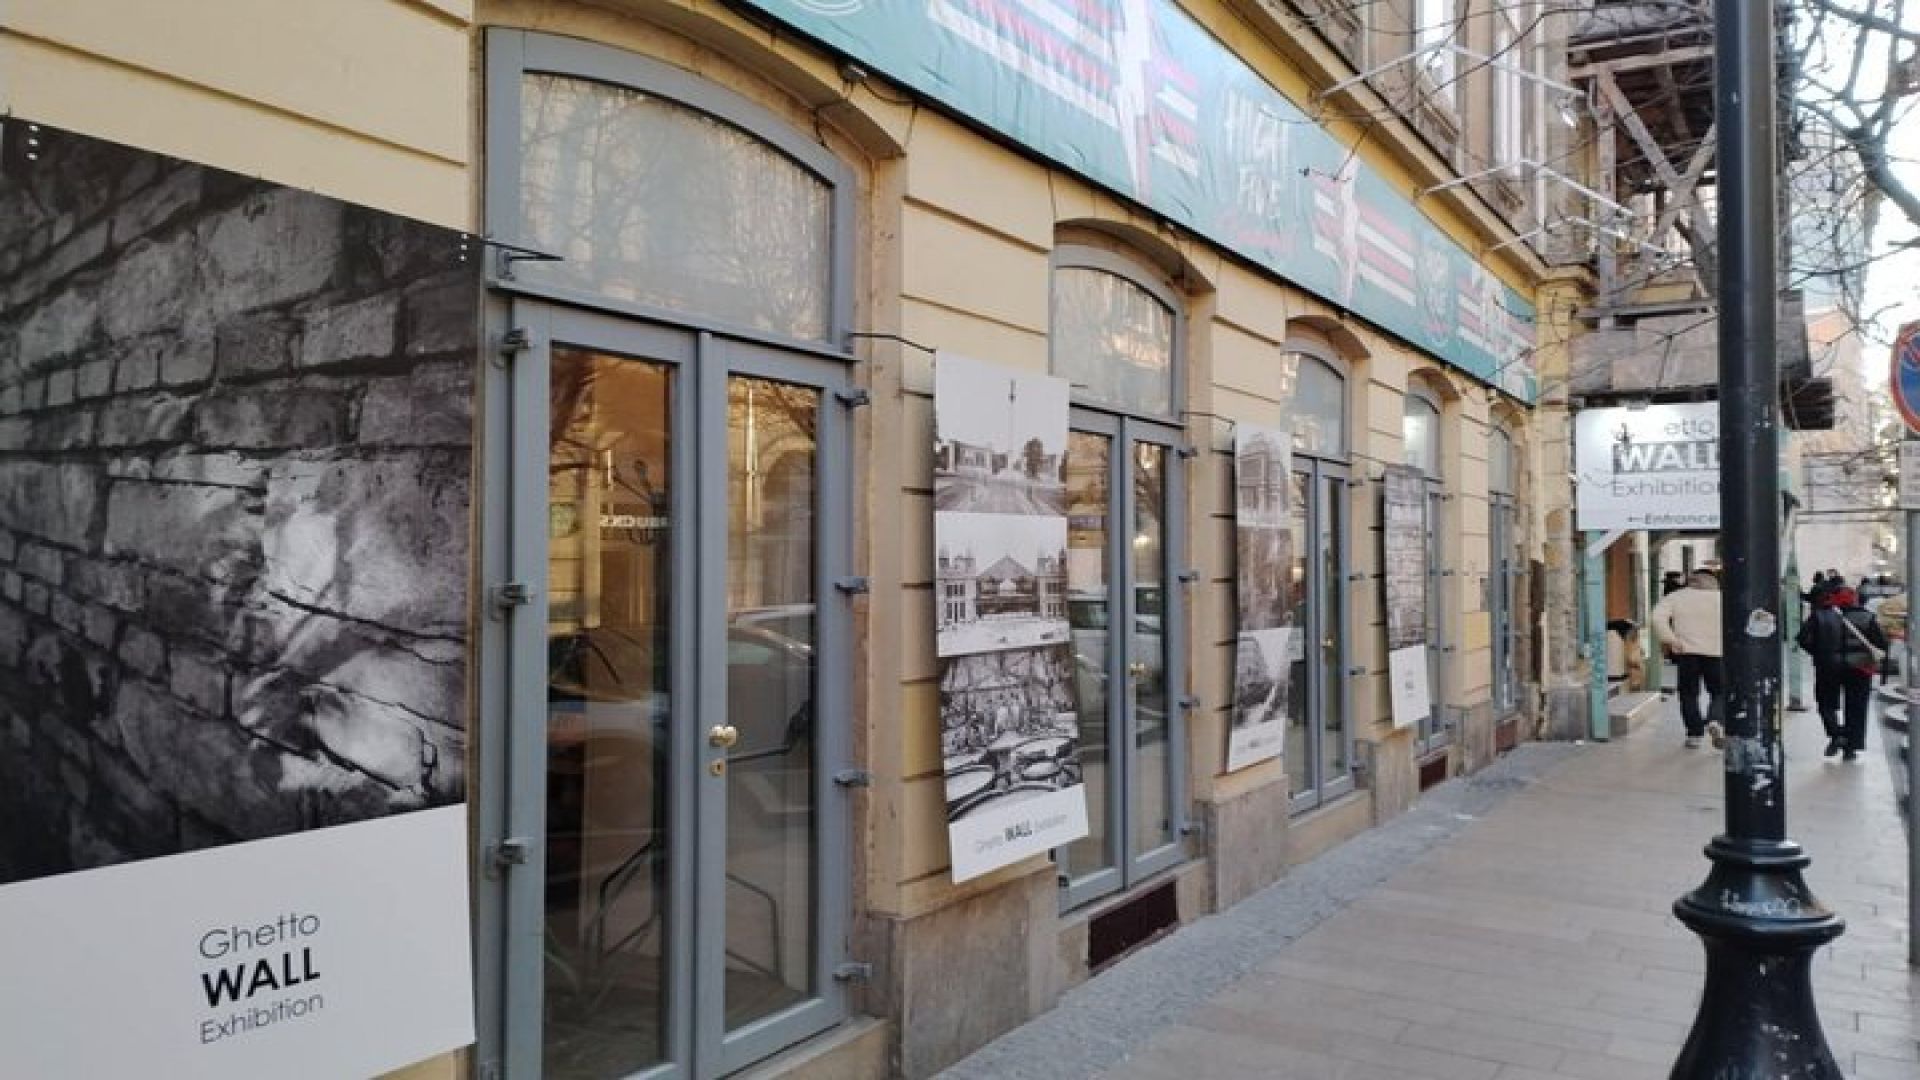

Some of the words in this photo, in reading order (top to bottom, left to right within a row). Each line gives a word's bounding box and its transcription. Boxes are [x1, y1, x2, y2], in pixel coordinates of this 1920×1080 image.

[1619, 443, 1721, 472] WALL
[199, 911, 320, 959] Ghetto
[201, 946, 321, 1008] WALL
[199, 994, 324, 1044] Exhibition
